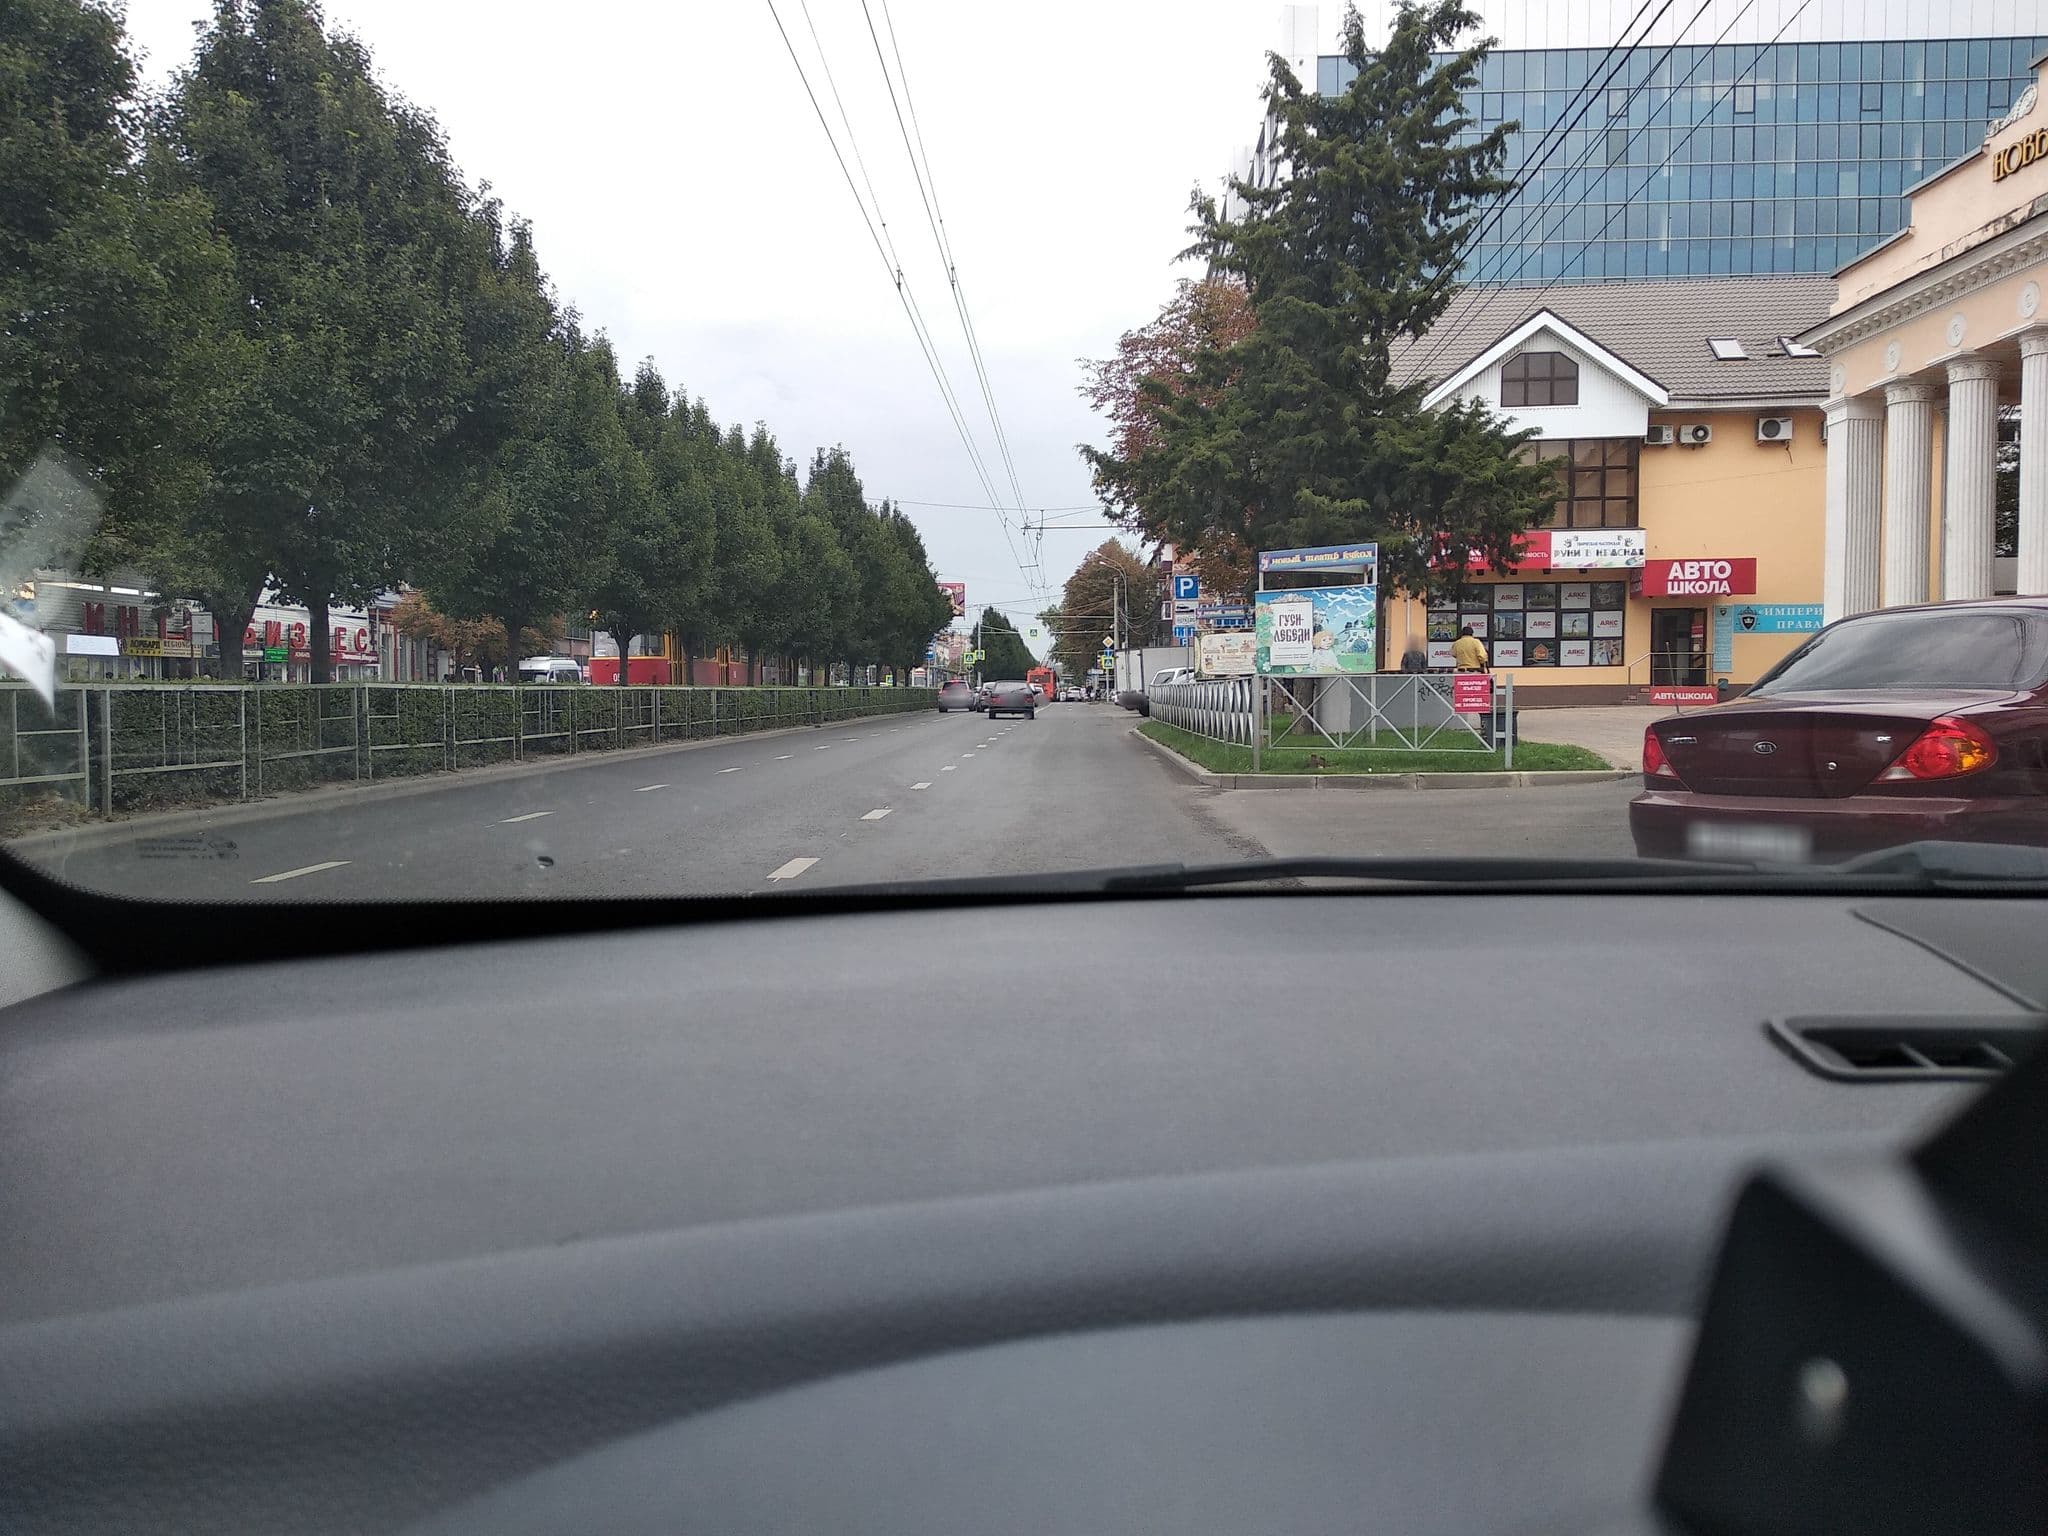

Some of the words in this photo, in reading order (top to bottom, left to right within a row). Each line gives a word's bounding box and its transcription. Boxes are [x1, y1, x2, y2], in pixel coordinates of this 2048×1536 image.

[1668, 561, 1732, 580] АВТО
[1667, 581, 1731, 595] ШКОЛА
[1279, 613, 1305, 627] ГУСИ-
[1777, 620, 1822, 629] ПРАВА
[1274, 628, 1310, 644] ЛЕБЕДИ
[1654, 692, 1713, 700] АВТОШКОЛА
